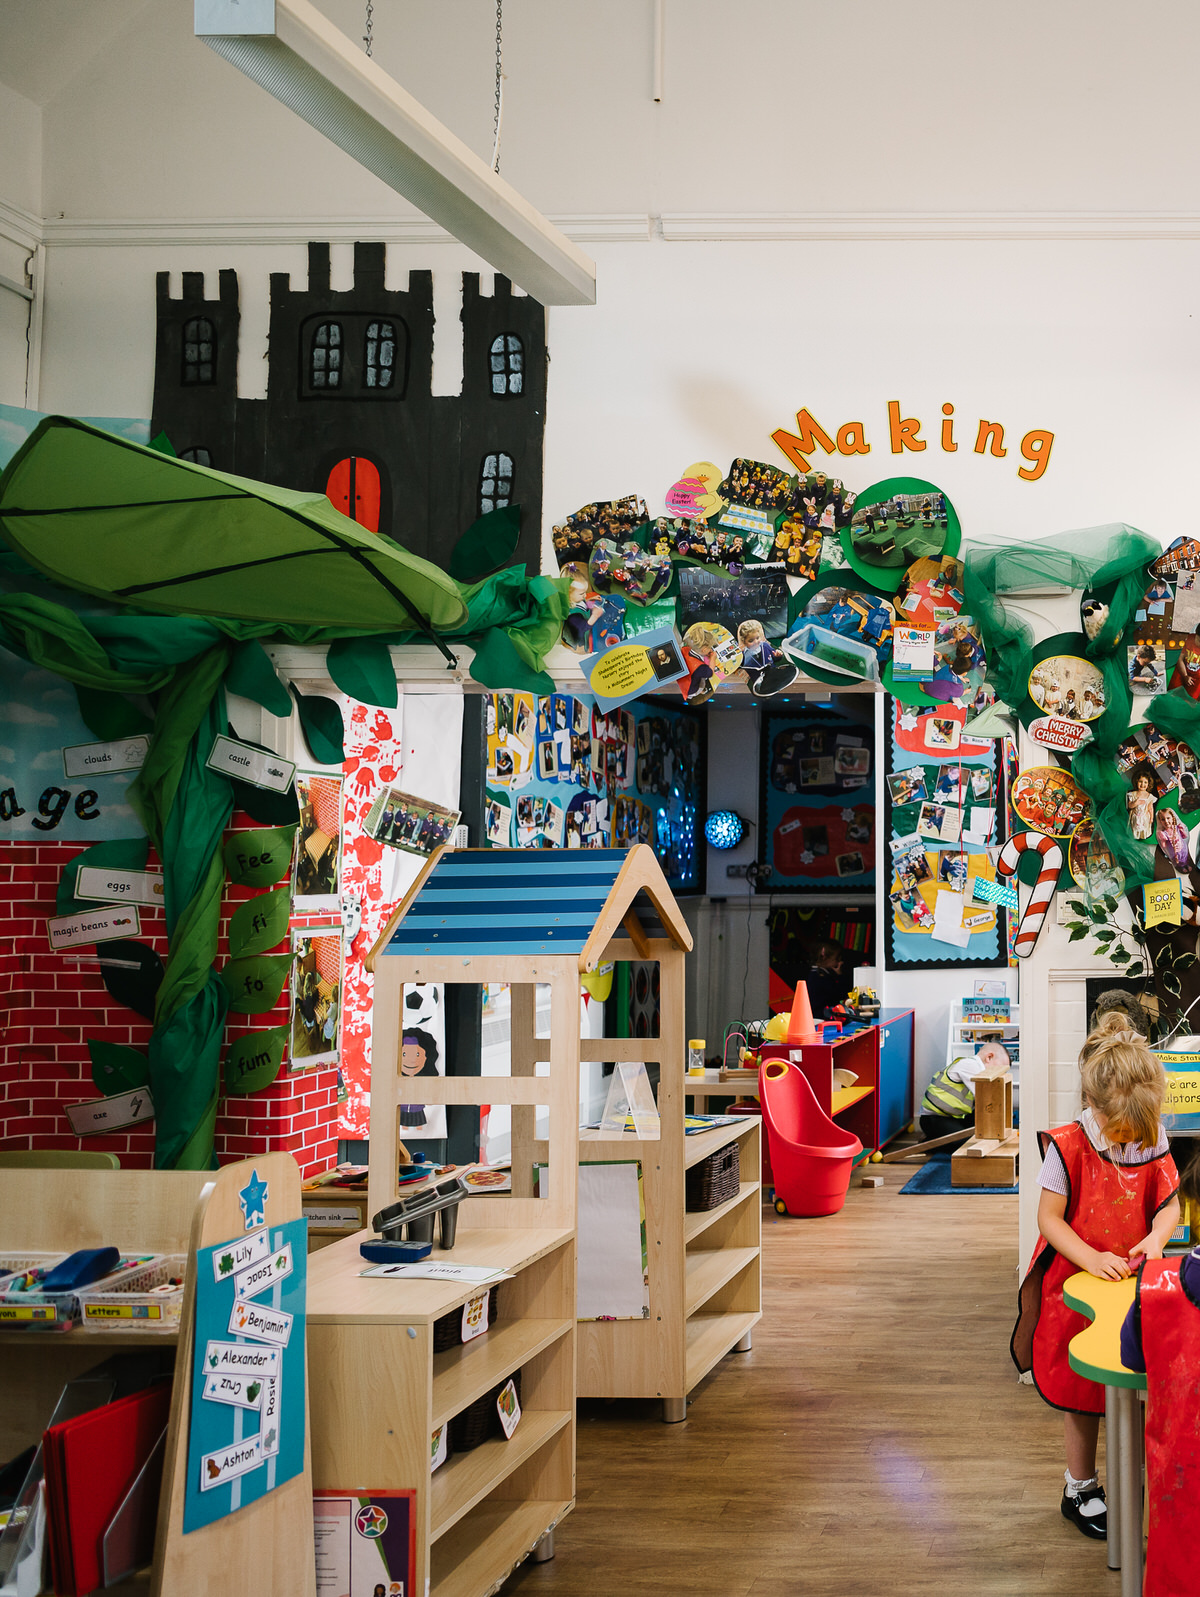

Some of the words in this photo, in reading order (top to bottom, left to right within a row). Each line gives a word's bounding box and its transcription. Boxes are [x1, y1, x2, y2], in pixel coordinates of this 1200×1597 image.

[770, 400, 1055, 481] Making
[674, 492, 690, 500] Happy
[899, 631, 930, 641] WORLD
[618, 662, 634, 672] enjoyed
[1050, 720, 1083, 736] MERRY
[84, 753, 112, 765] clouds
[228, 753, 250, 767] castle
[236, 851, 273, 871] Fee
[107, 880, 131, 892] eggs
[1150, 892, 1176, 904] BOOK
[1154, 902, 1172, 912] DAY
[53, 924, 79, 937] magic
[82, 920, 108, 932] beans
[252, 914, 267, 933] fi
[244, 977, 264, 995] fo
[237, 1051, 272, 1075] fum
[1180, 1081, 1198, 1089] are
[93, 1111, 107, 1120] axe
[236, 1247, 252, 1264] Lily
[246, 1264, 273, 1286] Isaac
[87, 1307, 120, 1316] Letters
[248, 1312, 284, 1334] Benjamin
[221, 1350, 268, 1367] Alexander
[220, 1378, 242, 1395] Cruz
[267, 1378, 276, 1416] Rosie
[222, 1448, 254, 1470] Ashton
